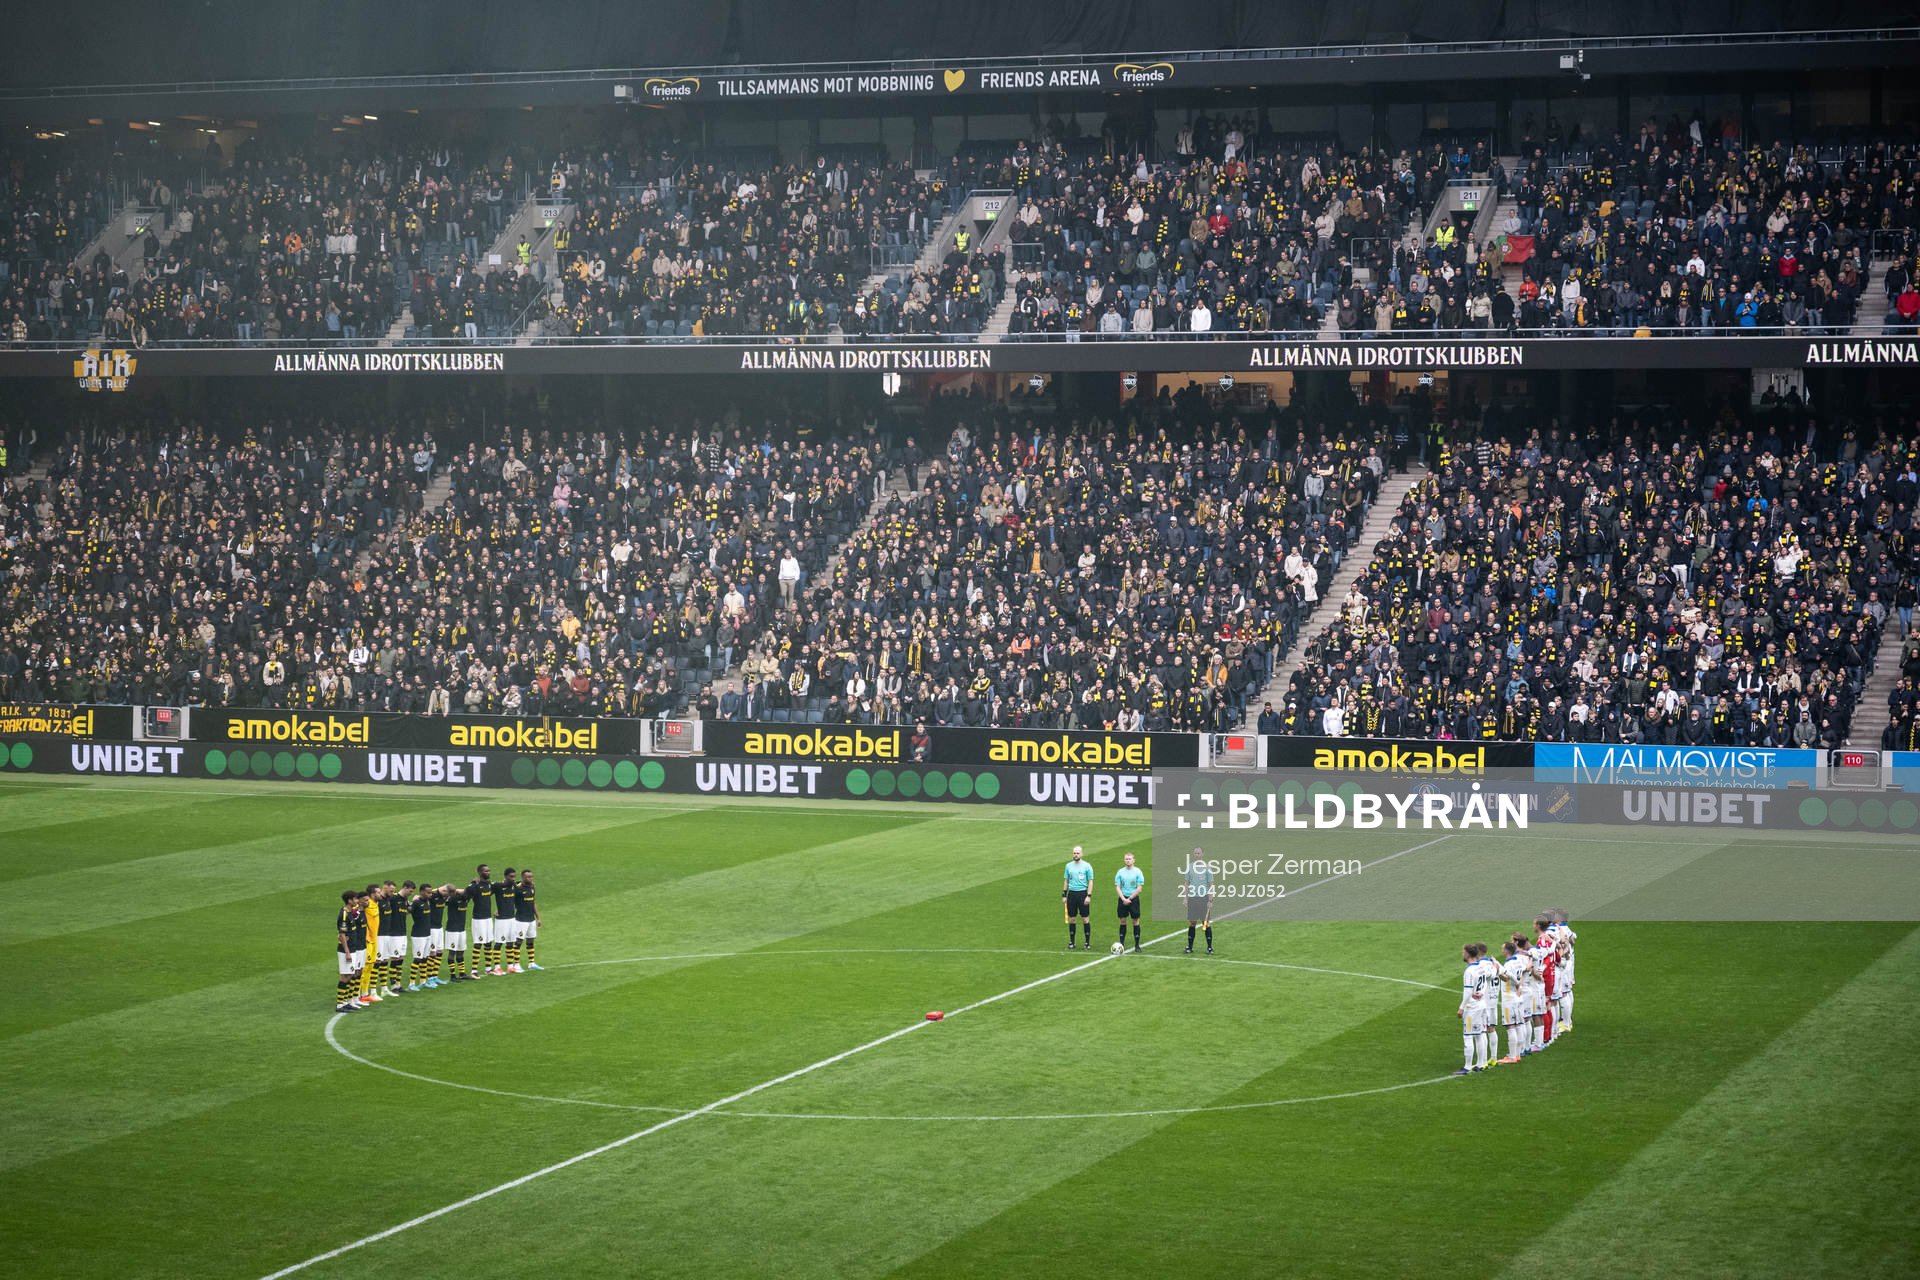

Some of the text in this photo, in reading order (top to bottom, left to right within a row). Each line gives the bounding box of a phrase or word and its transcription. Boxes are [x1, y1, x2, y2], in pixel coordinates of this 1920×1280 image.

[717, 75, 934, 96] TILLSAMMANS MOT MOBBNING
[980, 69, 1101, 89] FRIENDS ARENA
[1122, 69, 1165, 82] friends
[652, 84, 691, 96] friends
[984, 201, 1000, 210] 212
[1463, 192, 1478, 200] 211
[544, 209, 558, 217] 213
[274, 352, 504, 372] ALLMÄNNA IDROTTSKLUBBEN
[741, 348, 991, 369] ALLMÄNNA IDROTTSKLUBBEN
[1249, 344, 1523, 366] ALLMÄNNA IDROTTSKLUBBEN
[1806, 340, 1919, 363] ALLMÄNNA
[227, 714, 369, 743] amokabel
[450, 720, 597, 749] amokabel
[668, 725, 681, 733] 112
[744, 728, 900, 758] amokabel
[988, 735, 1151, 765] amokabel
[70, 744, 184, 774] UNIBET
[368, 753, 487, 784] UNIBET
[1313, 744, 1485, 775] amokabel
[1573, 746, 1776, 785] MALMQVIST
[1845, 755, 1862, 764] 110
[695, 762, 823, 795] UNIBET
[1029, 772, 1163, 805] UNIBET
[1622, 790, 1771, 825] UNIBET
